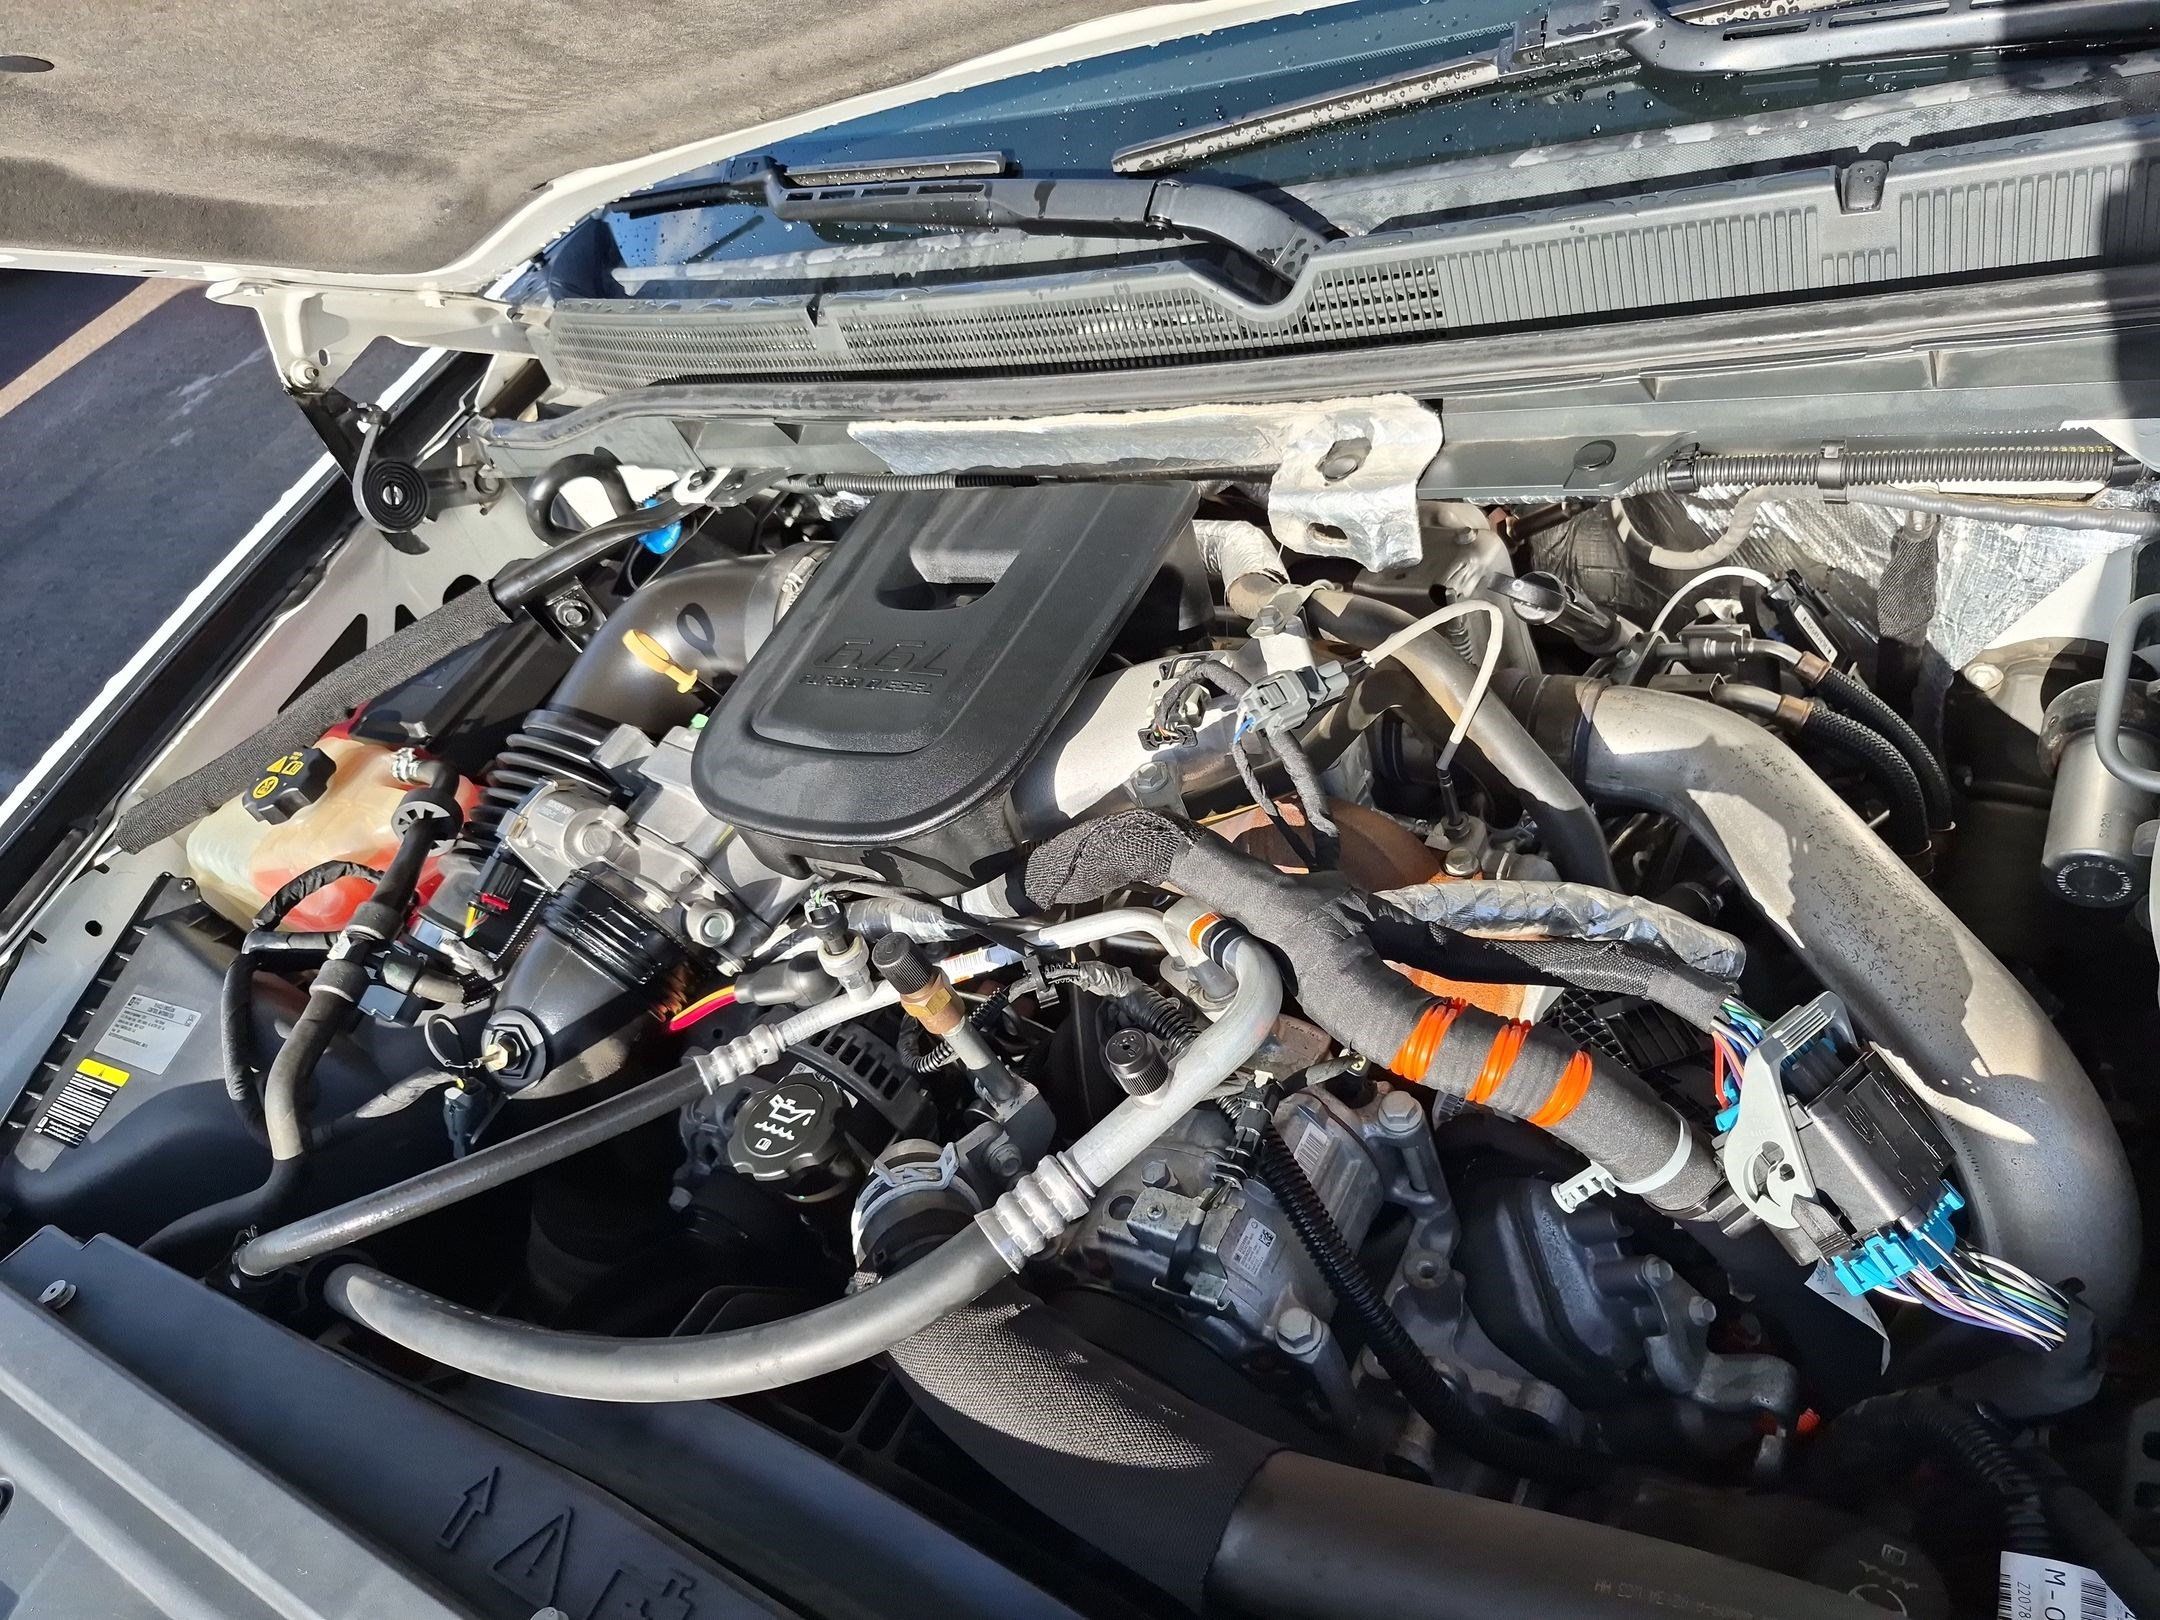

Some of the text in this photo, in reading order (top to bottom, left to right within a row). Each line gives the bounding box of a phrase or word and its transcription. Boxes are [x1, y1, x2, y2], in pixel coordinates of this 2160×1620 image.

[813, 637, 951, 677] 6.6L
[798, 673, 933, 695] TURBO DIESEL
